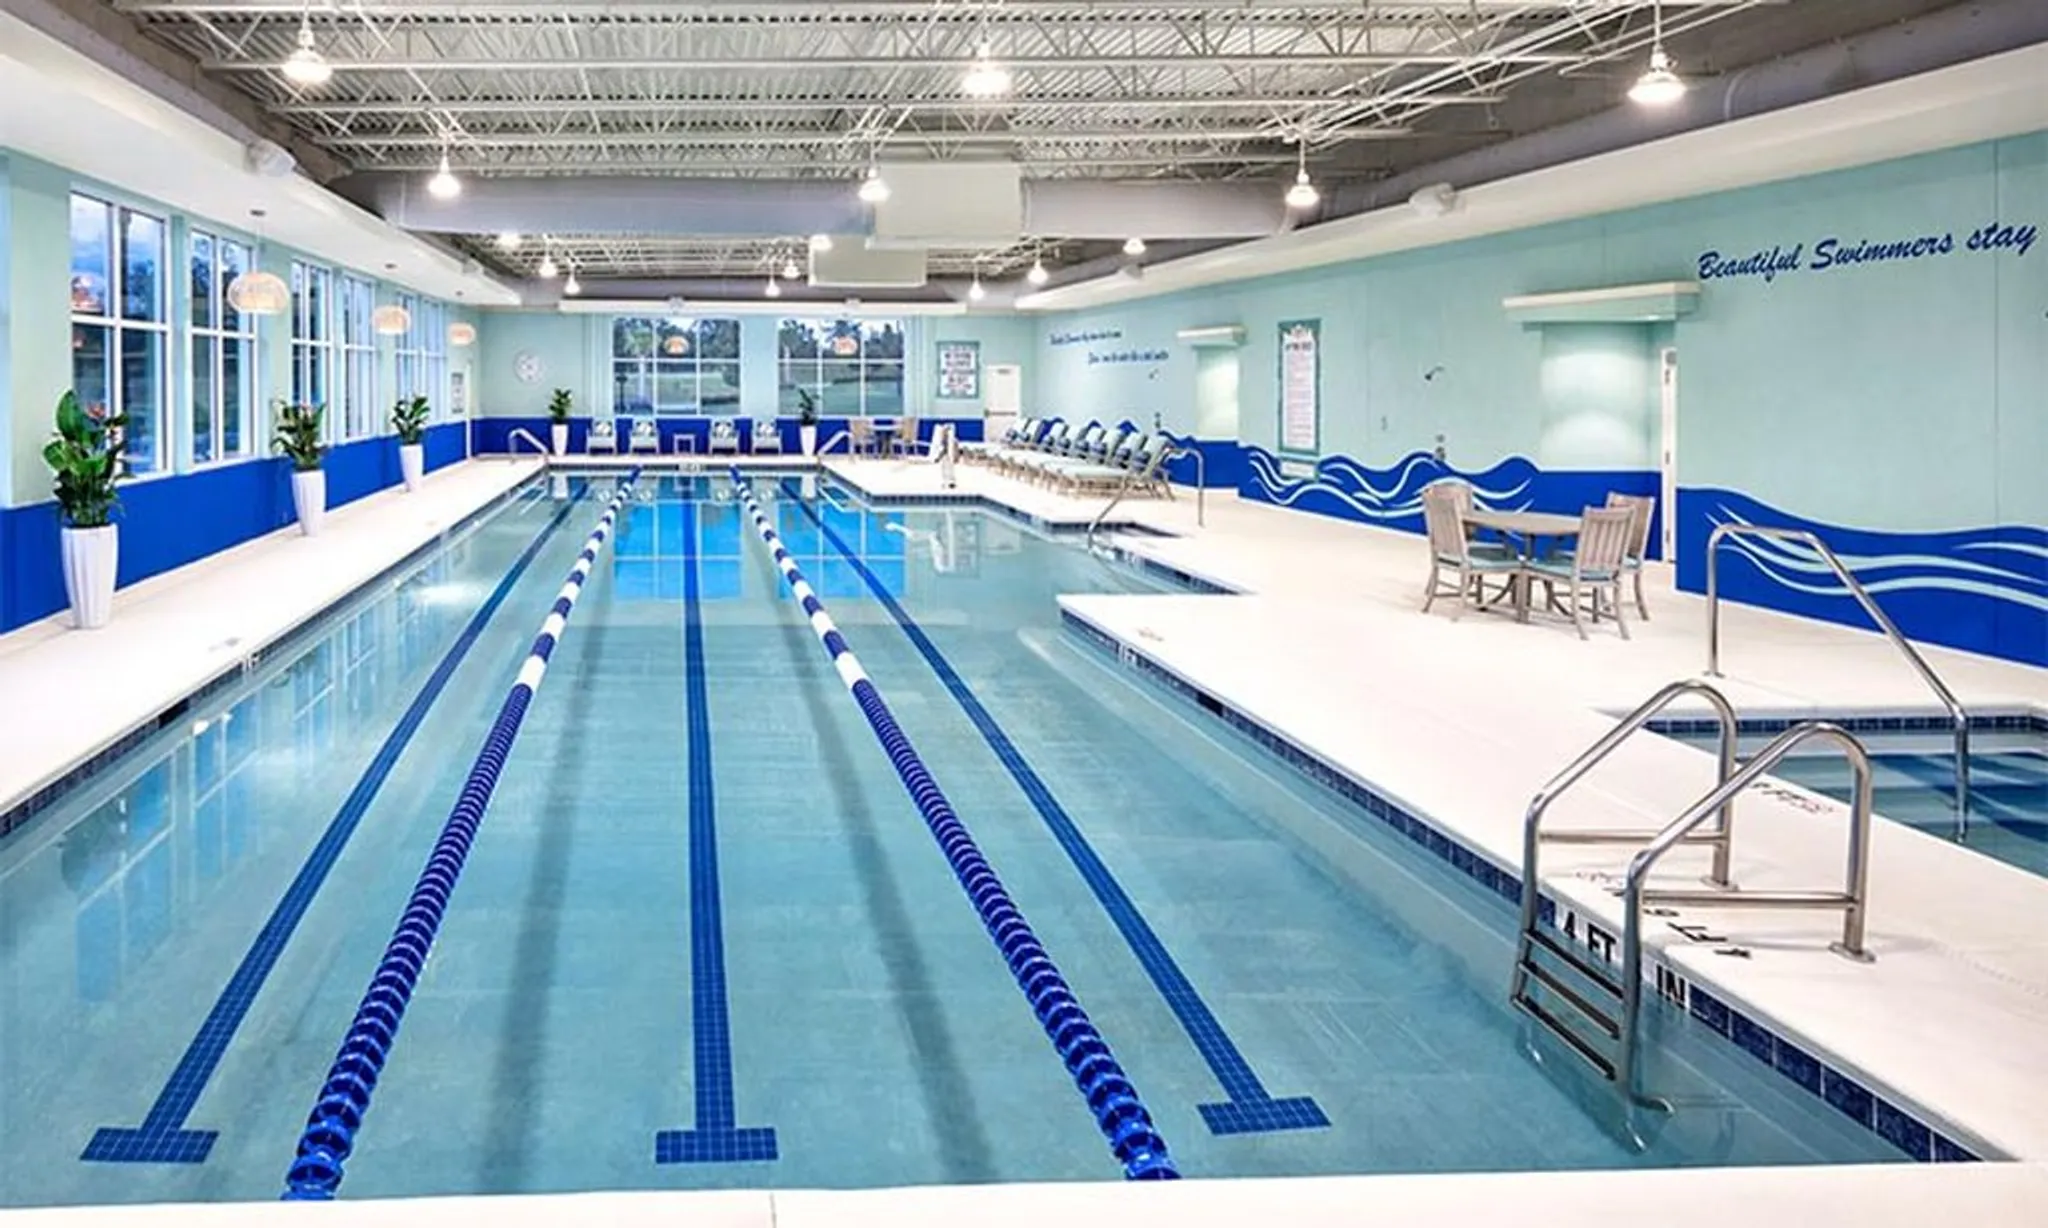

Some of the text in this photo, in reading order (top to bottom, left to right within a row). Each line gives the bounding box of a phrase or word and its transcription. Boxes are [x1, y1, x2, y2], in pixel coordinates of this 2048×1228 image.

[1698, 222, 2037, 282] Beautiful Swimmers stay
[1564, 911, 1686, 1008] 4 FT IN
